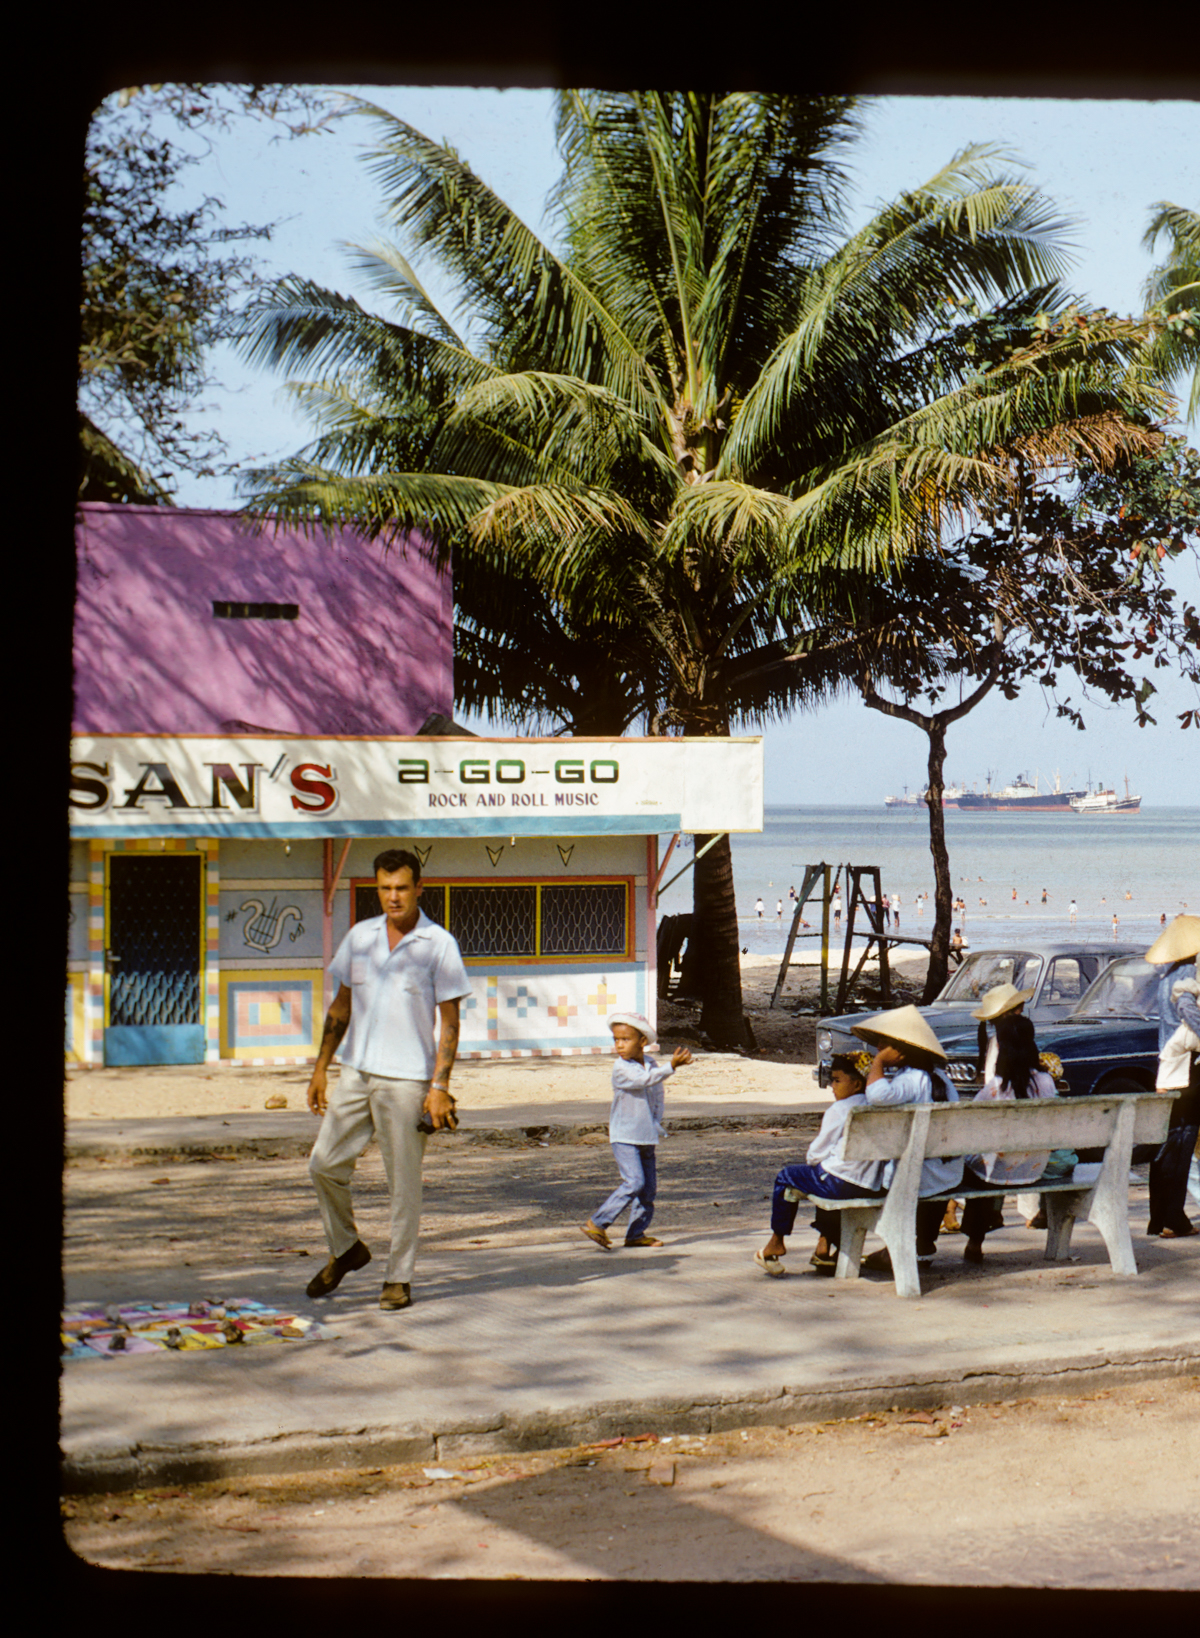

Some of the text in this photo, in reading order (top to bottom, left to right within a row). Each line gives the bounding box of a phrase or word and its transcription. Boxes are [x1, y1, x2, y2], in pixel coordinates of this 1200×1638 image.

[69, 753, 337, 812] SAN'S
[428, 792, 600, 808] ROCK AND ROLL MUSIC
